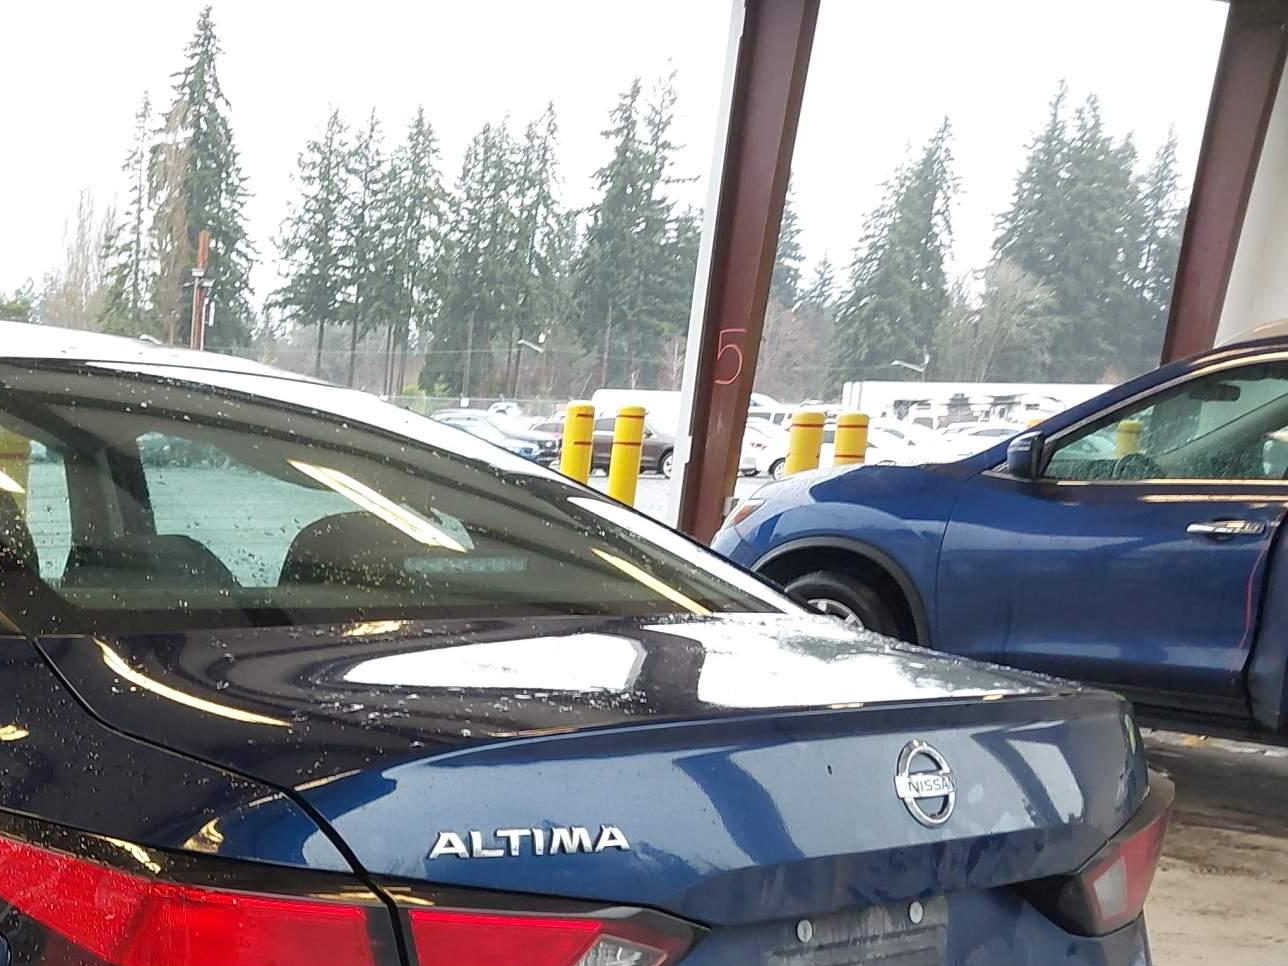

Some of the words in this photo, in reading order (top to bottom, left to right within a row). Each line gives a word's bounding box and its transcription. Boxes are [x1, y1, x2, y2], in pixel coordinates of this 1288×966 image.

[714, 327, 747, 385] 5
[907, 774, 956, 794] NISSAN
[427, 823, 631, 860] ALTIMA
